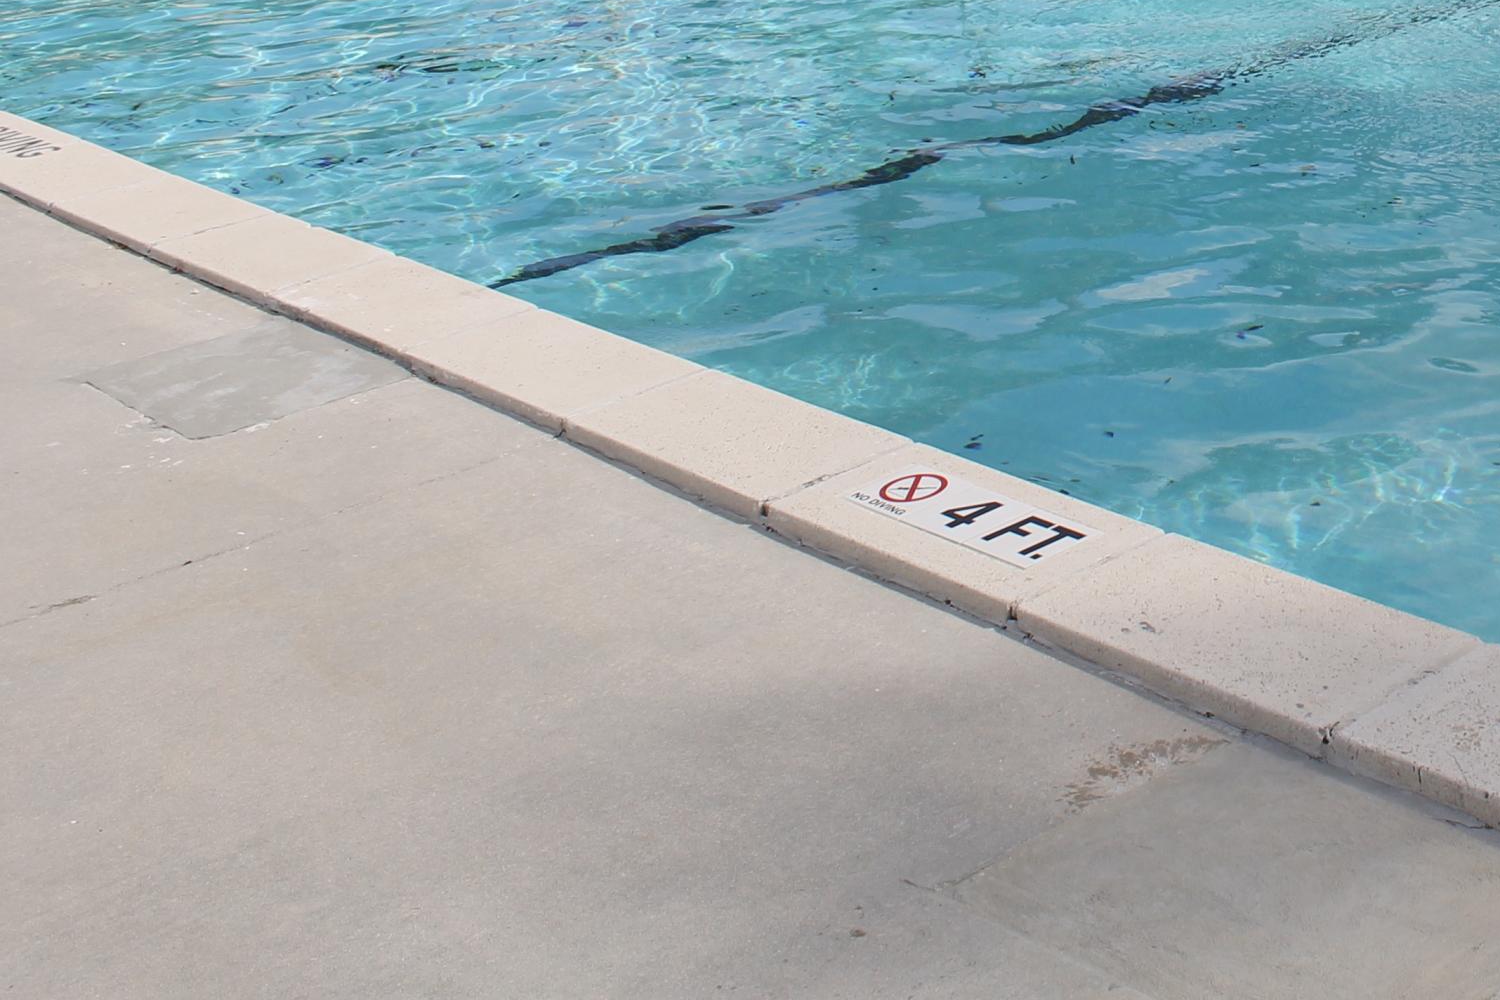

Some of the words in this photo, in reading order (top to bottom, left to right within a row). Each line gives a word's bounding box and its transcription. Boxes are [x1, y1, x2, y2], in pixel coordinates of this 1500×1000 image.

[850, 491, 870, 501] NO
[868, 498, 907, 516] DIVING
[940, 501, 1004, 529] 4
[981, 515, 1088, 560] FT.
